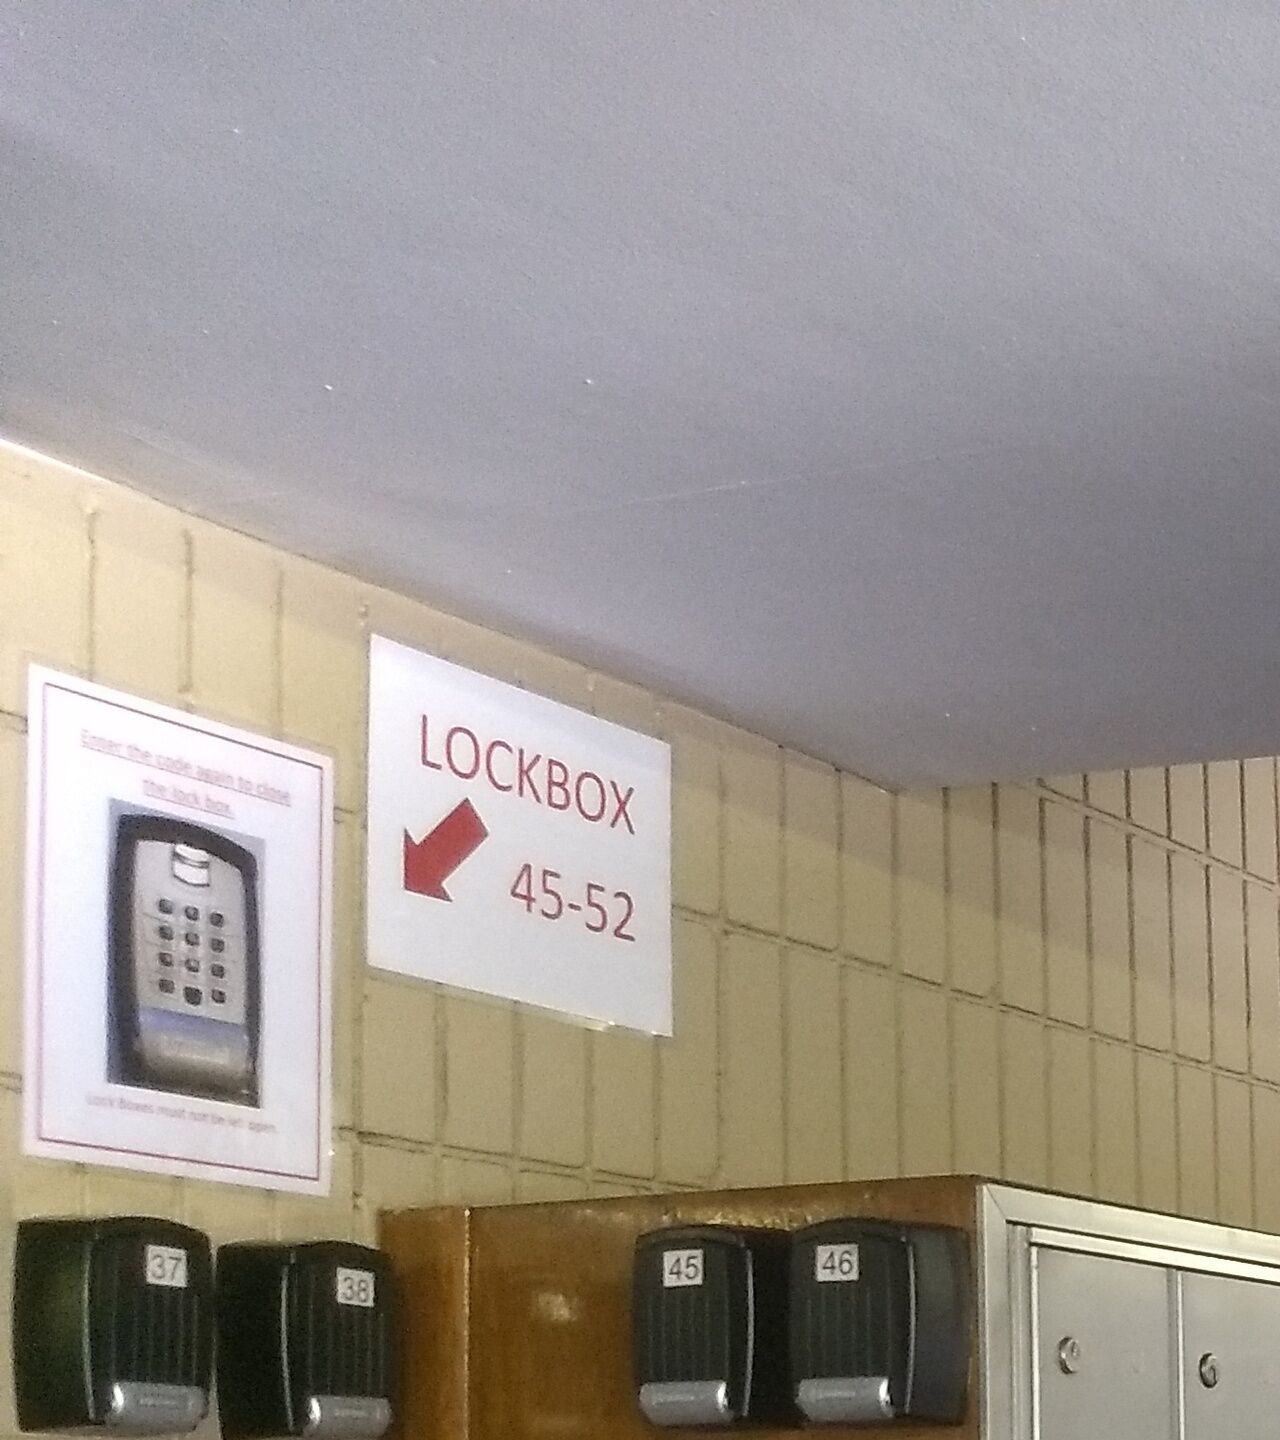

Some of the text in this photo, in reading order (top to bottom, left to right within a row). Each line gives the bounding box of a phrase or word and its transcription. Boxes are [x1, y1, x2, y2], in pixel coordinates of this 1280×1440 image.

[421, 714, 635, 835] LOCKBOX
[510, 863, 636, 942] 45-52
[149, 1253, 183, 1282] 37
[668, 1254, 700, 1281] 45
[821, 1248, 854, 1276] 46
[341, 1275, 371, 1303] 38
